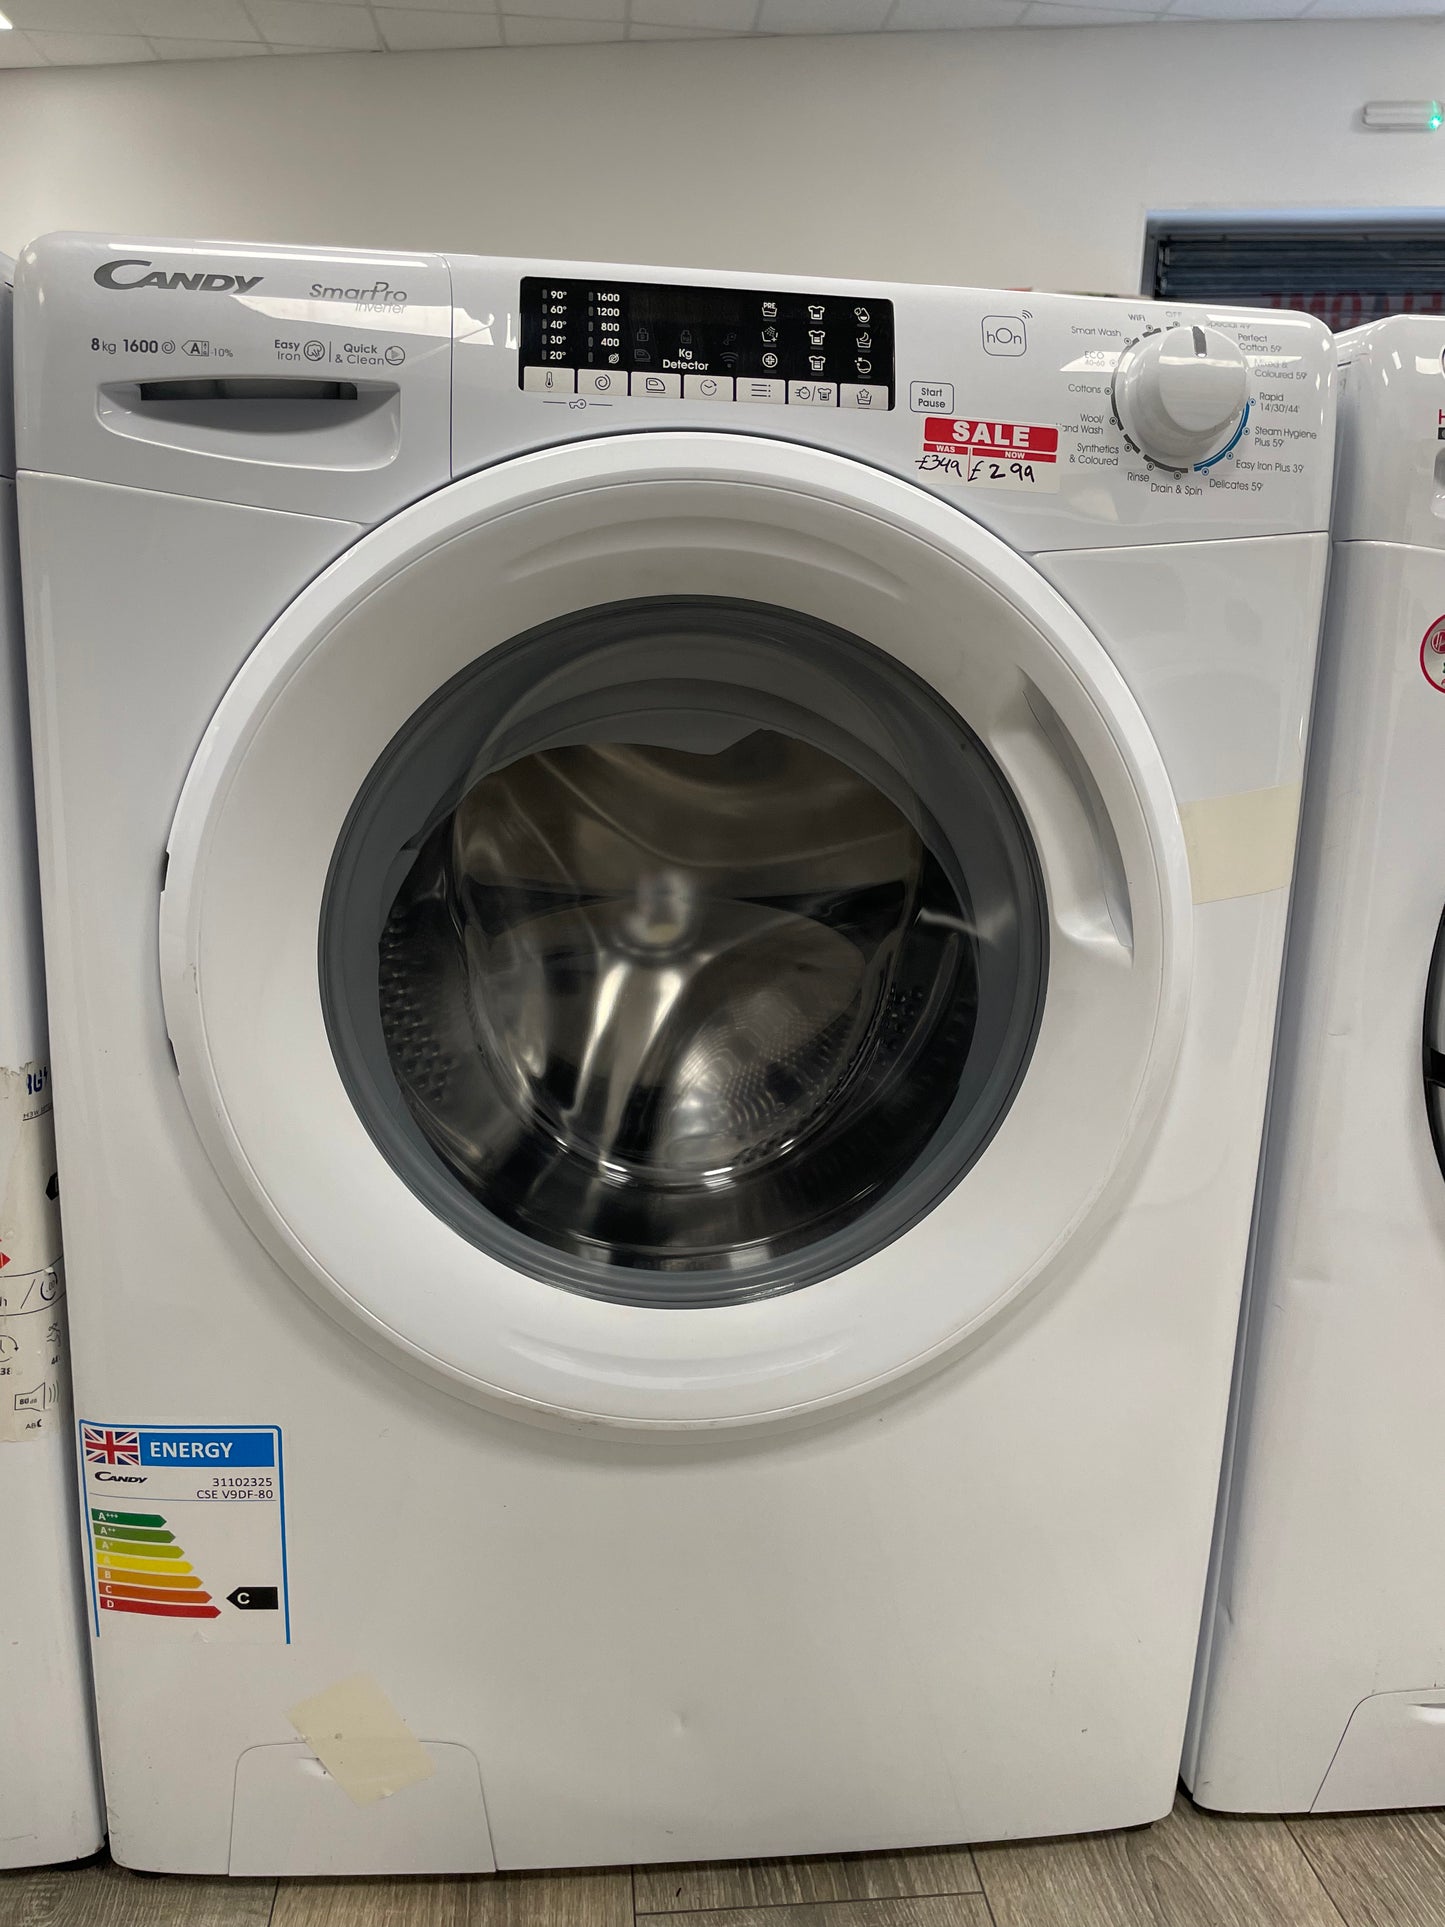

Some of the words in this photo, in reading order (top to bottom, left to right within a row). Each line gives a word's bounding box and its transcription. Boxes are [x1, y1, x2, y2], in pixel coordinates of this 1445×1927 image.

[93, 259, 264, 294] CANDY
[597, 292, 620, 303] 1600
[597, 307, 620, 318] 1200
[601, 322, 620, 333] 800
[1071, 325, 1096, 336] Smart
[1099, 327, 1122, 338] Wash
[986, 327, 1022, 344] hOn
[1237, 332, 1268, 343] Perfect
[90, 337, 100, 351] 8
[102, 340, 117, 355] kg
[122, 339, 159, 353] 1600
[274, 339, 301, 352] Easy
[343, 343, 378, 354] Quick
[601, 337, 620, 348] 400
[1239, 343, 1268, 353] Cotton
[277, 350, 301, 361] Iron
[335, 353, 343, 364] &
[346, 354, 385, 366] Clean
[678, 348, 692, 360] Kg
[1084, 351, 1105, 360] ECO
[662, 358, 709, 371] Detector
[1254, 369, 1294, 380] Coloured
[921, 387, 943, 397] Start
[1067, 383, 1102, 395] Cottons
[1259, 391, 1284, 403] Rapid
[918, 398, 946, 409] Pause
[1080, 413, 1105, 425] Wool/
[951, 420, 1030, 448] SALE
[1081, 424, 1104, 436] Wash
[1254, 426, 1282, 437] Steam
[1283, 428, 1318, 440] Hygiene
[936, 444, 955, 453] WAS
[1254, 437, 1271, 448] Plus
[1076, 442, 1120, 456] Synthetics
[1004, 451, 1025, 460] NOW
[1069, 454, 1076, 464] &
[1077, 455, 1119, 467] Coloured
[915, 455, 962, 478] £349
[1236, 459, 1255, 472] Easy
[1257, 461, 1273, 471] Iron
[1274, 462, 1291, 473] Plus
[989, 462, 1035, 483] 299
[1127, 471, 1150, 483] Rinse
[1150, 482, 1173, 495] Drain
[1175, 485, 1182, 495] &
[1184, 485, 1203, 497] Spin
[1209, 478, 1249, 491] Delicates
[150, 1442, 233, 1458] ENERGY
[94, 1471, 148, 1484] CANDY
[212, 1477, 273, 1487] 31102325
[196, 1490, 218, 1500] CSE
[222, 1489, 274, 1500] V9DF-80
[104, 1570, 111, 1579] B
[105, 1585, 112, 1594] C
[107, 1600, 115, 1608] D
[237, 1592, 250, 1605] C
